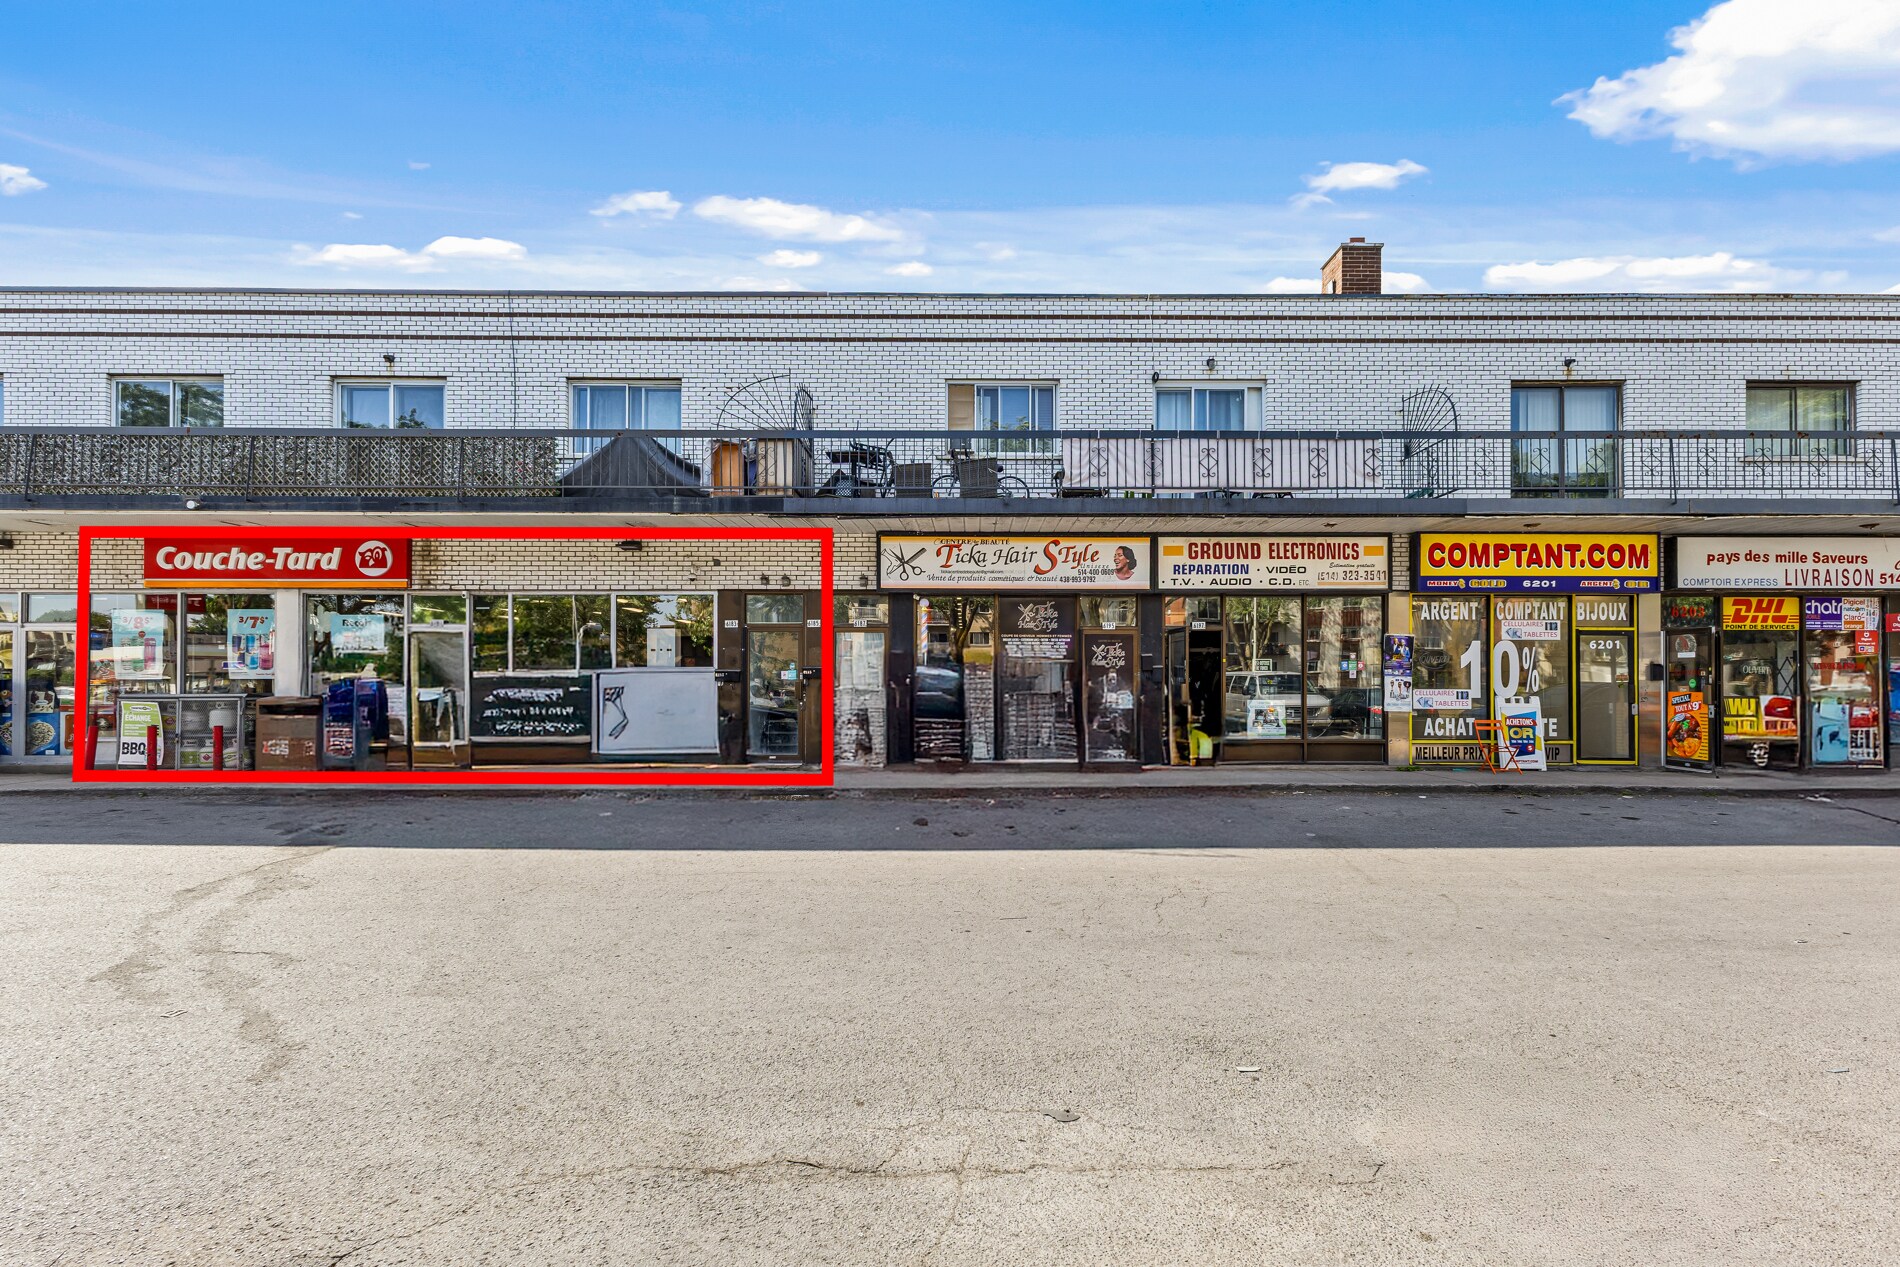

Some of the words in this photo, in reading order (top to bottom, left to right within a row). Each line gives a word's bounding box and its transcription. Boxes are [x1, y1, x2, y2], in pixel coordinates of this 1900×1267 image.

[936, 542, 988, 568] Ticka
[991, 546, 1038, 566] Hair
[1188, 542, 1261, 560] GROUND
[1268, 542, 1360, 560] ELECTRONICS
[1427, 542, 1650, 569] COMPTANT.COM
[1706, 551, 1741, 565] pays
[1744, 549, 1770, 563] des
[1775, 551, 1808, 564] mille
[1812, 551, 1868, 565] Saveurs
[156, 546, 343, 570] Couche-Tard
[1173, 563, 1249, 575] RÉPARATION
[927, 573, 947, 581] Vente
[948, 573, 956, 581] de
[957, 574, 986, 583] produits
[1035, 574, 1058, 582] beauté
[1342, 570, 1387, 581] 323-3541
[1784, 568, 1874, 586] LIVRAISON
[1171, 578, 1195, 586] T.V.
[1210, 578, 1252, 586] AUDIO
[1268, 578, 1296, 586] C.D.
[1522, 580, 1557, 588] 6201
[1682, 578, 1732, 587] COMPTOIR
[1735, 578, 1778, 587] EXPRESS
[1843, 598, 1866, 606] Digicel
[1421, 602, 1478, 620] ARGENT
[1496, 602, 1566, 620] COMPTANT
[1576, 603, 1627, 620] BIJOUX
[1671, 606, 1705, 618] 6203
[1730, 598, 1789, 624] DHL
[1589, 640, 1620, 649] 6201
[1424, 717, 1475, 736] ACHAT
[1506, 718, 1533, 726] ACHETONS
[1509, 728, 1534, 739] OR
[121, 742, 147, 755] BBQ
[1415, 747, 1461, 760] MEILLEUR
[1464, 747, 1485, 760] PRIX
